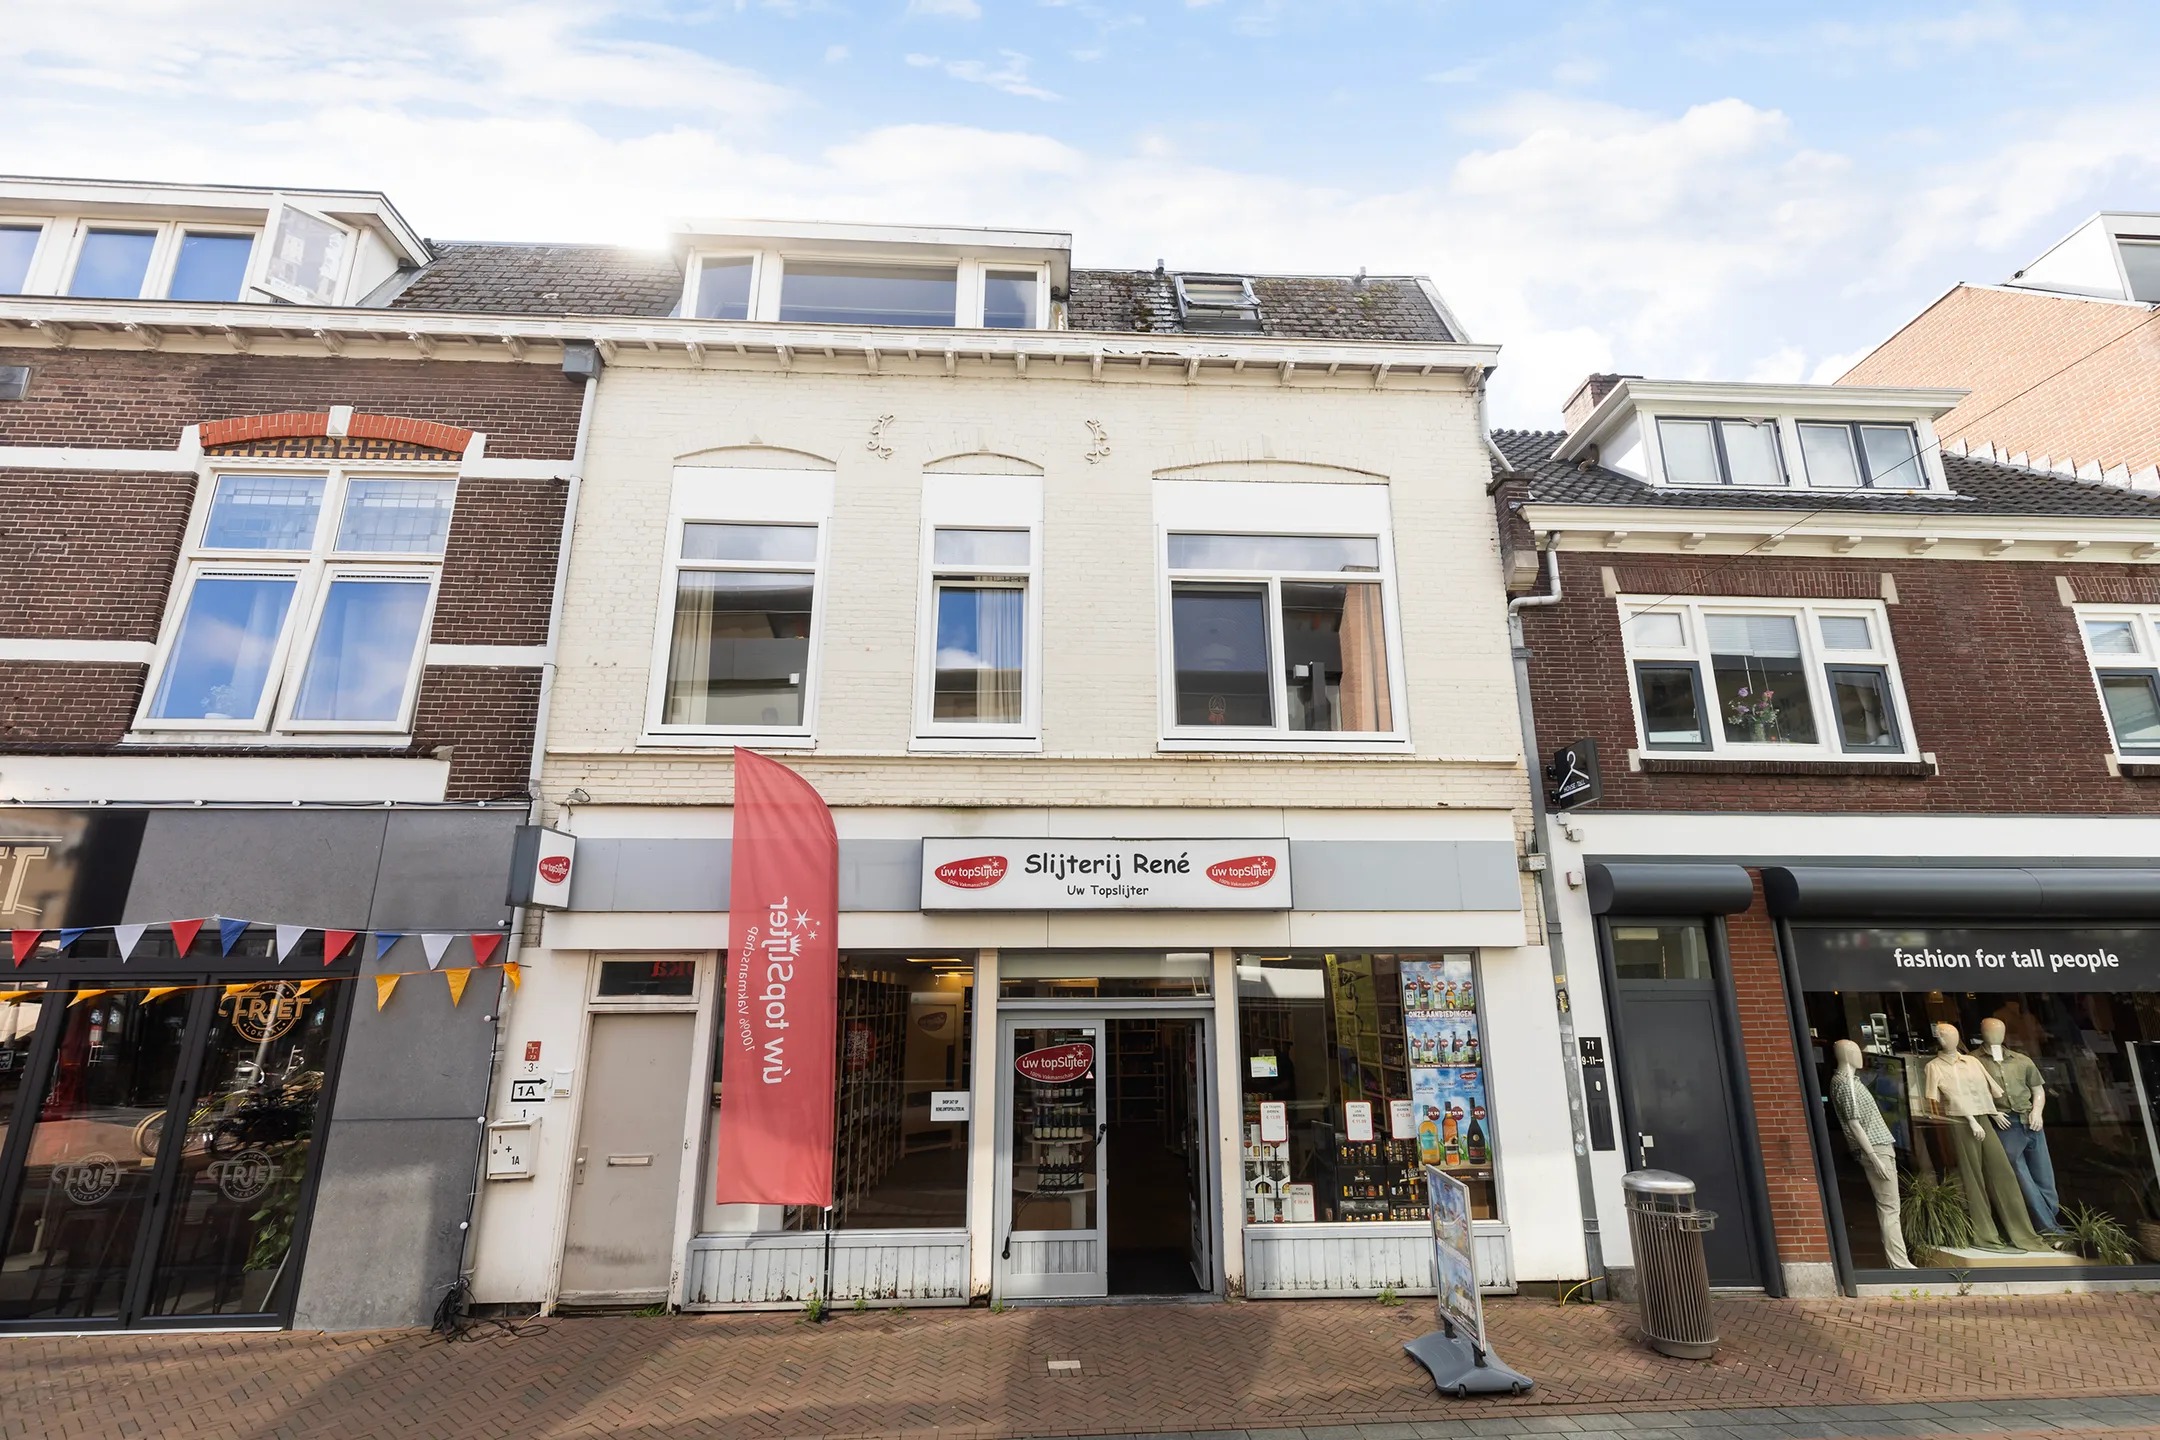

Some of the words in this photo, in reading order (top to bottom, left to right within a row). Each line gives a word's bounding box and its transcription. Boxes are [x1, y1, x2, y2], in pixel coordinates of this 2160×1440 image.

[941, 866, 957, 877] úw
[959, 866, 1004, 879] topSlijter
[1024, 852, 1121, 881] Slijterij
[1134, 852, 1191, 874] René
[1211, 866, 1227, 877] úw
[1229, 866, 1273, 878] topSlijter
[1067, 885, 1086, 896] Uw
[1090, 885, 1150, 899] Topslijter
[1894, 948, 1971, 968] fashion
[1975, 948, 2006, 968] for
[2011, 948, 2045, 968] tall
[2049, 948, 2119, 973] people
[218, 991, 313, 1027] FRIET
[1408, 1010, 1425, 1018] ONZE
[1585, 1040, 1591, 1050] 7
[1022, 1057, 1039, 1069] úw
[1041, 1056, 1089, 1071] topSlijter
[1581, 1056, 1596, 1065] 9-11
[528, 1062, 534, 1073] 3
[518, 1085, 536, 1097] 1A
[522, 1109, 527, 1118] 1
[511, 1156, 520, 1165] 1A
[51, 1162, 129, 1191] FRIET
[207, 1159, 282, 1187] FRIET
